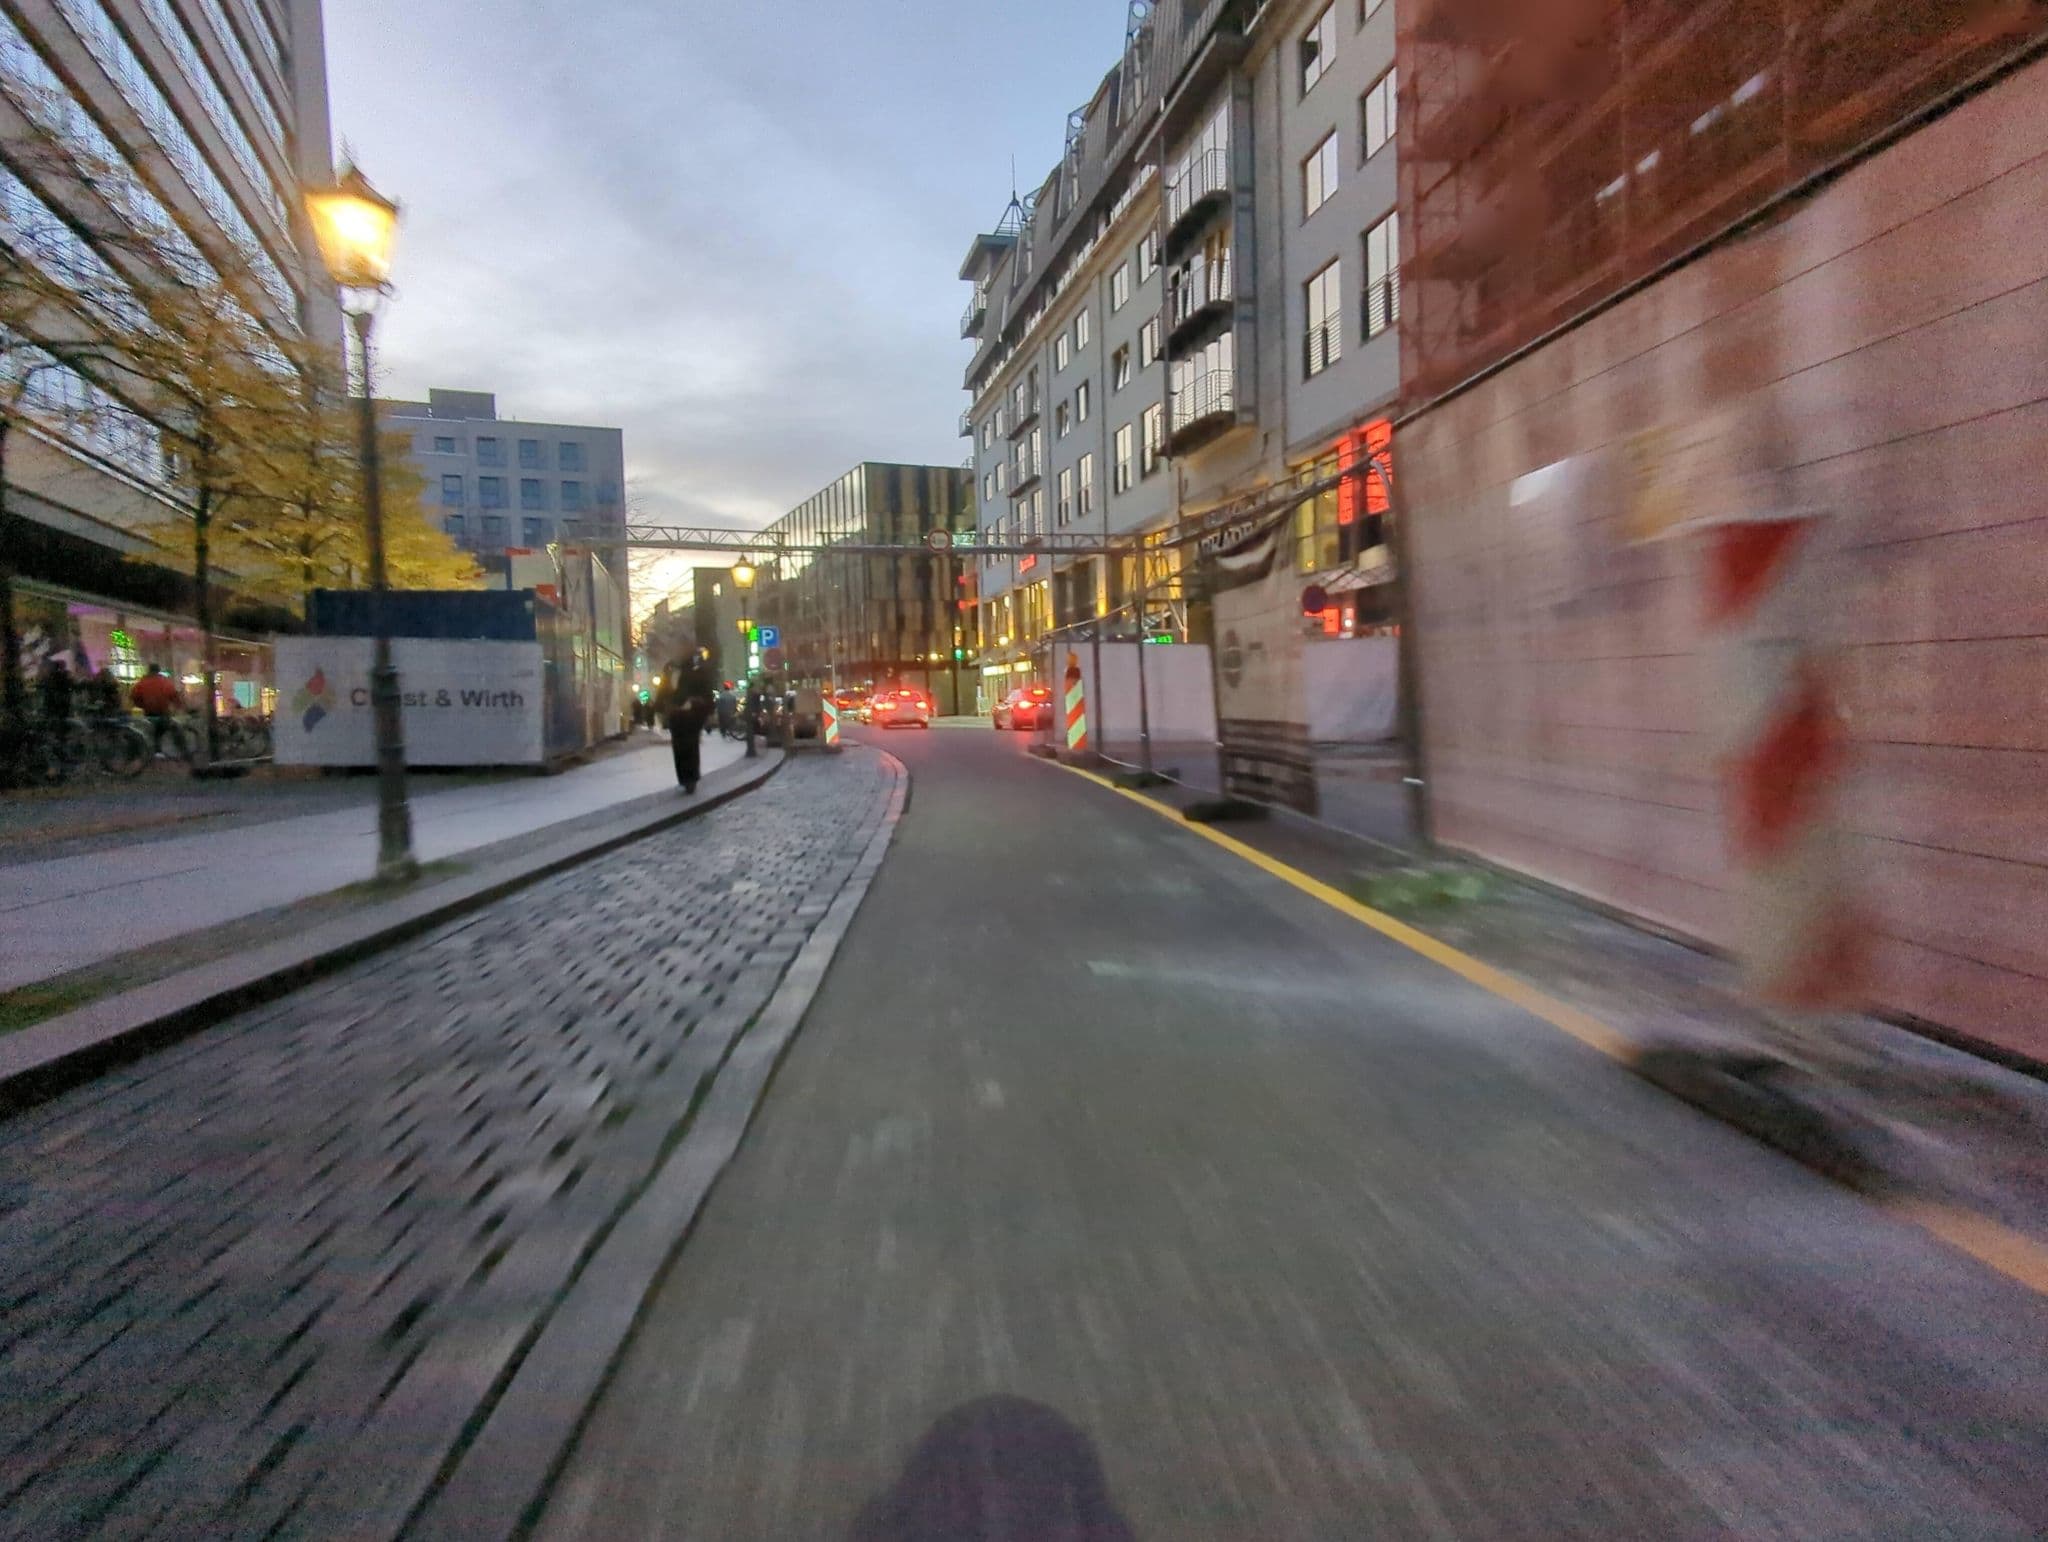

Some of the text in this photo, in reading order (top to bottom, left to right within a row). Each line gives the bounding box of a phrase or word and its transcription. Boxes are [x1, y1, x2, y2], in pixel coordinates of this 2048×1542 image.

[762, 629, 774, 646] P
[351, 688, 524, 708] Cst & Wirth
